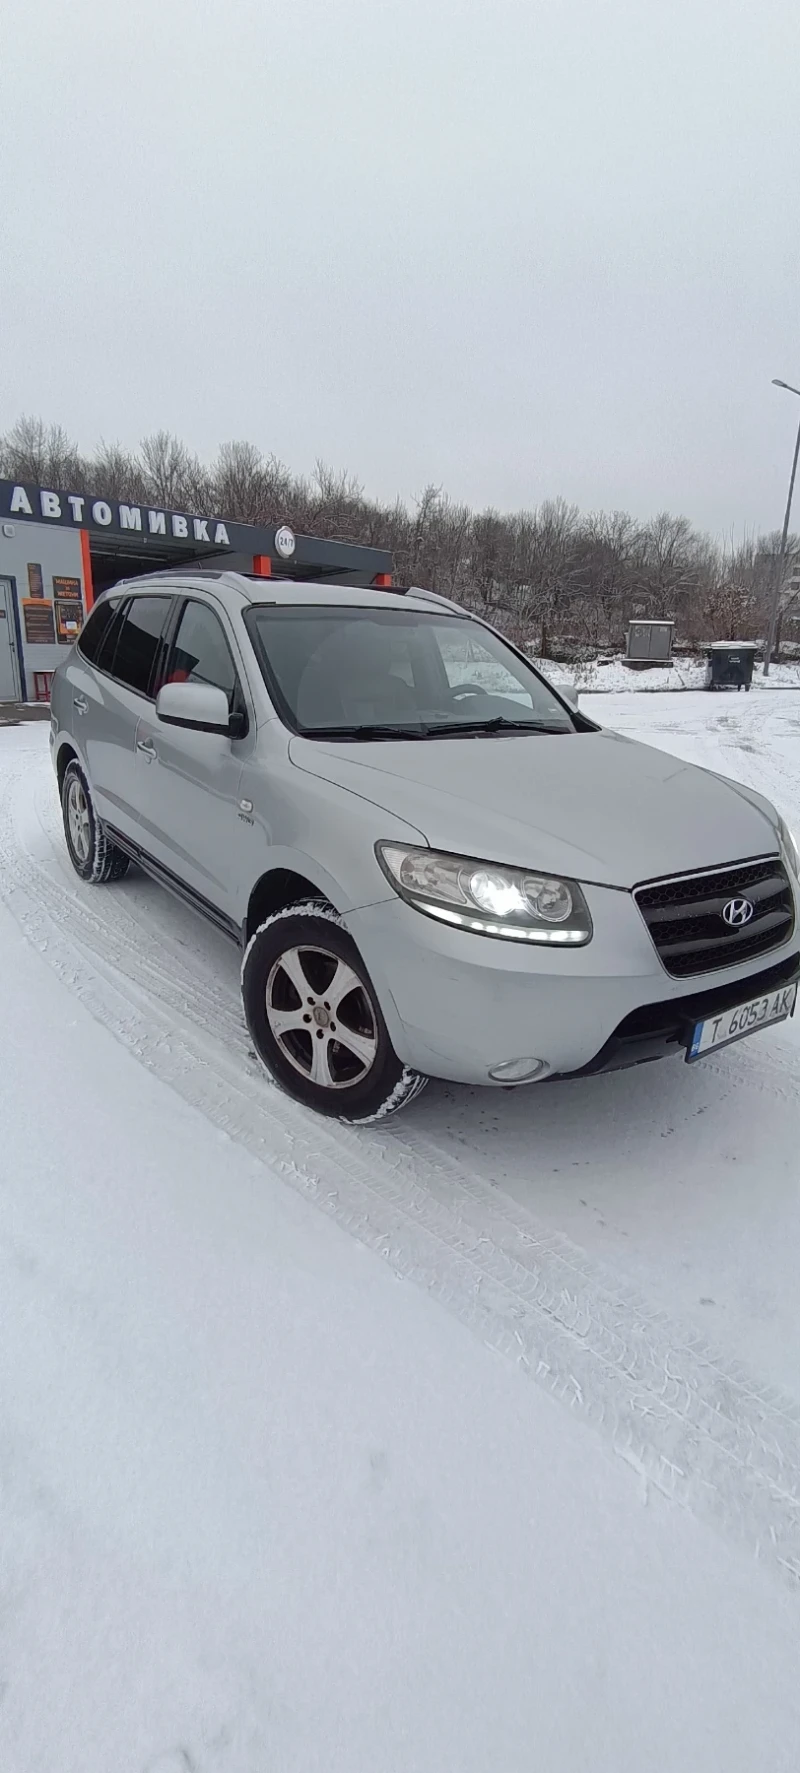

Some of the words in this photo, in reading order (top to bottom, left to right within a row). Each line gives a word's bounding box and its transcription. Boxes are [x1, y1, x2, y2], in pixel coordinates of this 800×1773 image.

[10, 486, 230, 545] АВТОМИВКА
[280, 536, 294, 548] 24/7
[712, 1018, 722, 1043] T
[729, 998, 769, 1034] 6053
[770, 988, 792, 1015] AK
